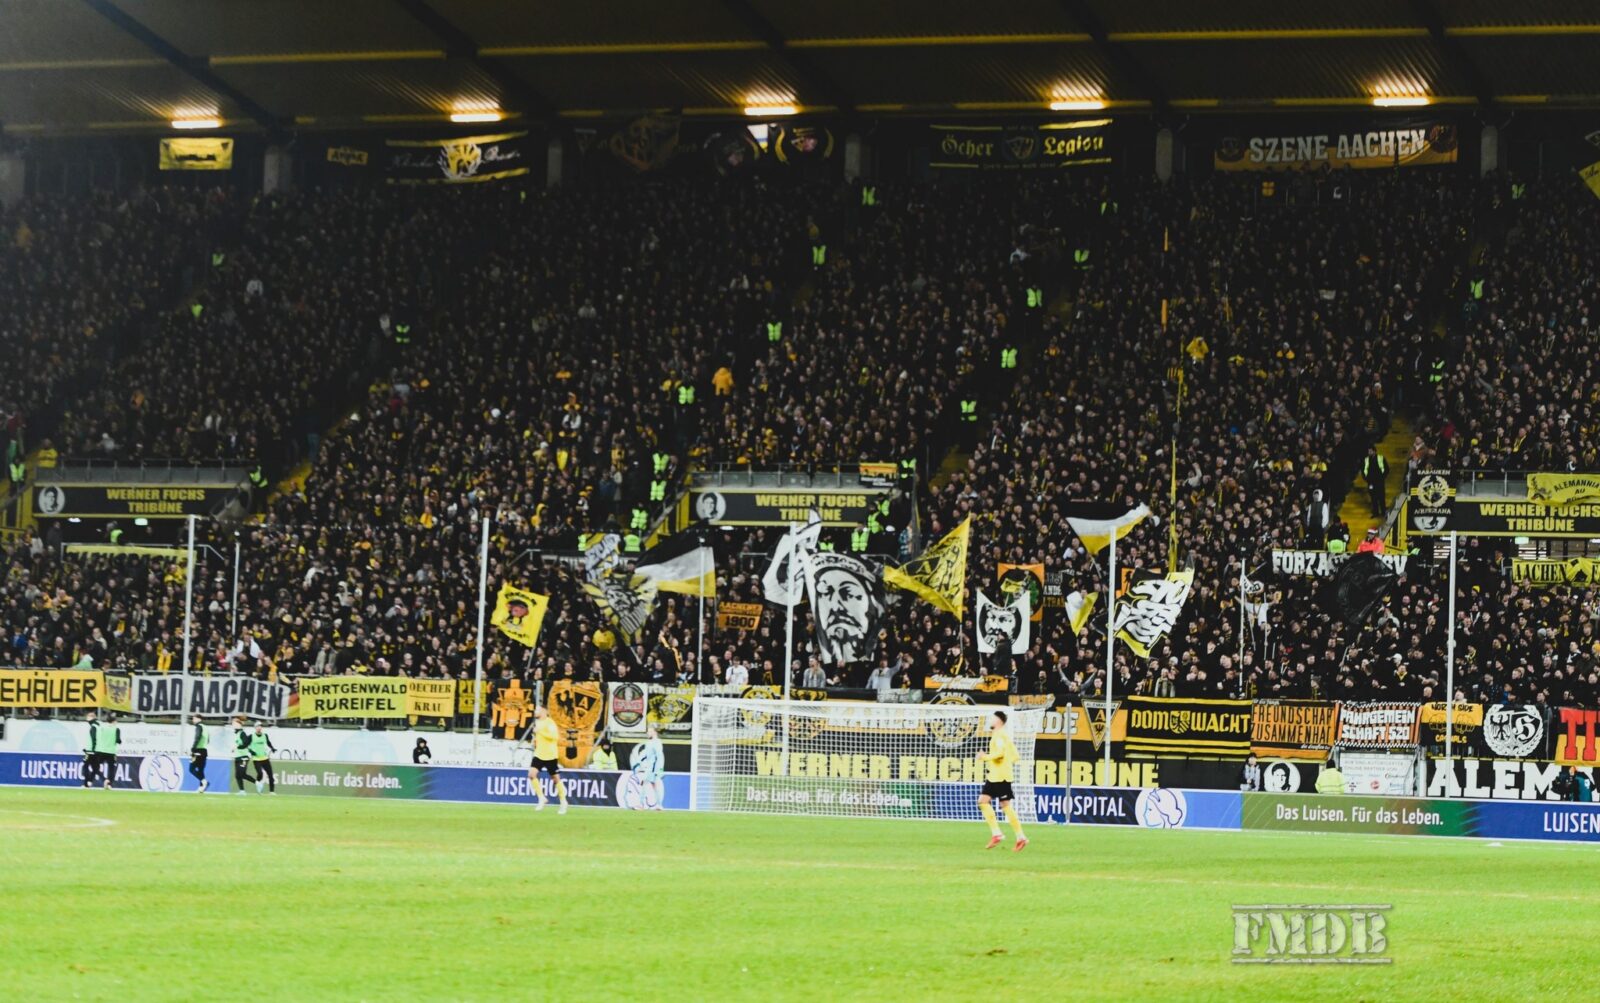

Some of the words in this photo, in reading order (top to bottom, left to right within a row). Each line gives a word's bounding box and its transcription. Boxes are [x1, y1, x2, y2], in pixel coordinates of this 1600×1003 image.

[942, 134, 995, 158] Öcher
[1043, 135, 1105, 157] Legion
[1250, 135, 1329, 163] SZENE
[1336, 128, 1427, 161] AACHEN
[106, 488, 160, 500] WERNER
[162, 488, 205, 501] FUCHS
[755, 494, 816, 508] WERNER
[818, 495, 867, 508] FUCHS
[128, 501, 183, 513] TRIBÜNE
[780, 508, 842, 520] TRIBNE
[1480, 503, 1547, 516] WERNER
[1550, 504, 1600, 518] FUCHS
[1506, 517, 1575, 531] TRIBÜNE
[1272, 551, 1330, 576] FORZA
[725, 615, 756, 628] 1900
[409, 682, 452, 693] OECHER
[138, 678, 183, 712] BAD
[190, 678, 284, 717] AACHEN
[315, 698, 397, 711] RUREIFEL
[1131, 709, 1170, 730] DOM
[1190, 712, 1250, 734] WACHT
[1341, 725, 1387, 740] SCHAFT
[755, 751, 891, 779] WERNER
[899, 756, 990, 782] FUCH
[281, 769, 320, 786] Luisen.
[323, 771, 341, 787] Für
[343, 772, 364, 788] das
[366, 773, 402, 789] Leben.
[746, 787, 768, 802] Das
[816, 788, 836, 803] Für
[839, 788, 860, 805] das
[1276, 804, 1298, 821] Das
[1303, 805, 1348, 823] Luisen.
[1352, 806, 1372, 823] Für
[1375, 807, 1399, 824] das
[1402, 808, 1443, 826] Leben.
[1544, 811, 1600, 834] LUISEN
